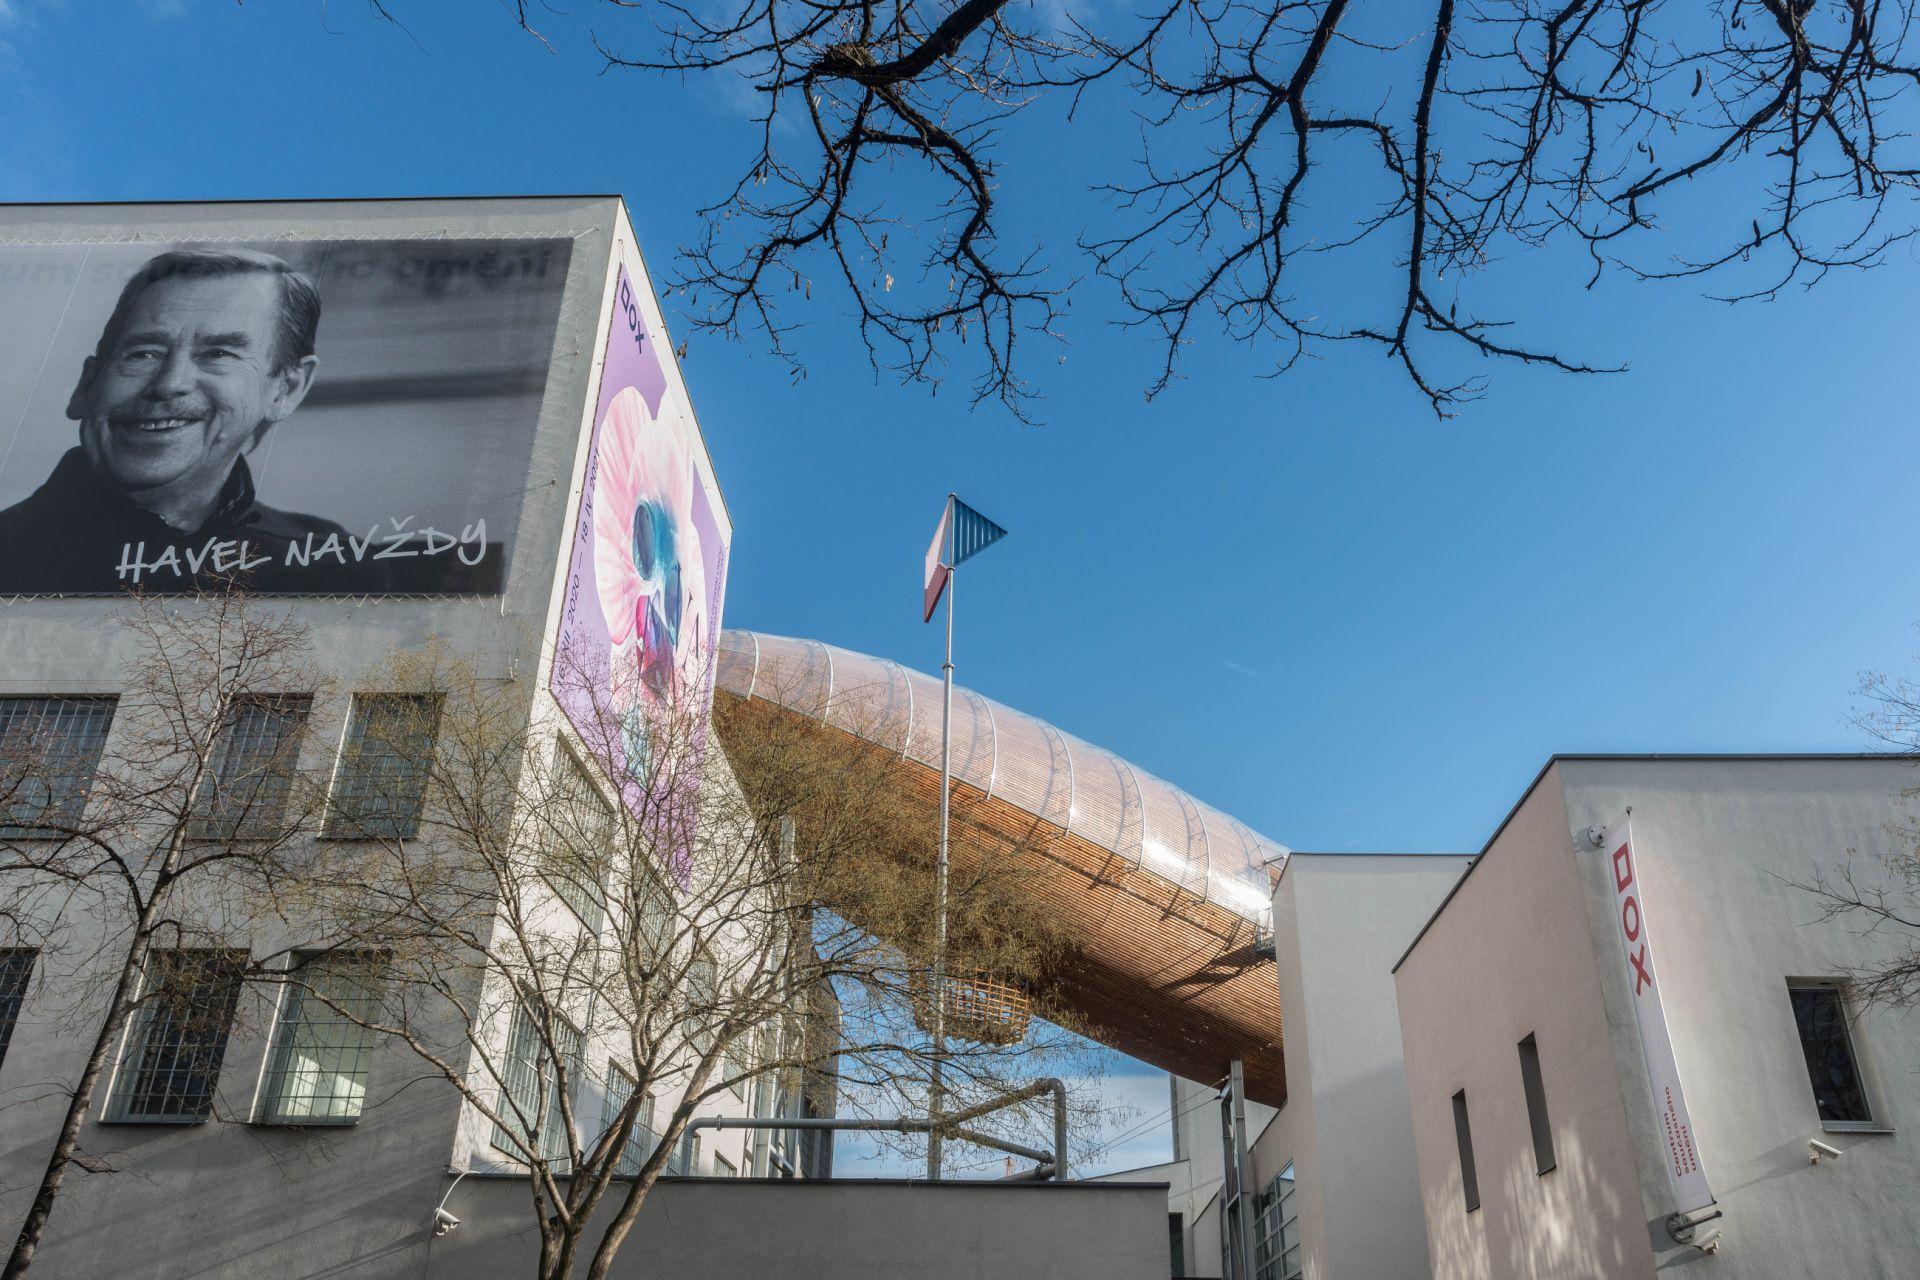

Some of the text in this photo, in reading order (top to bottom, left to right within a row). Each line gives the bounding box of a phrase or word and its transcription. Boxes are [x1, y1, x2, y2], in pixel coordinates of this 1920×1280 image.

[115, 535, 272, 583] HAVEL
[568, 574, 580, 625] 2020
[581, 521, 589, 544] 18
[585, 494, 592, 517] IV
[590, 447, 600, 492] 2021
[1664, 1112, 1682, 1177] Centrum
[1681, 1125, 1697, 1172] umění
